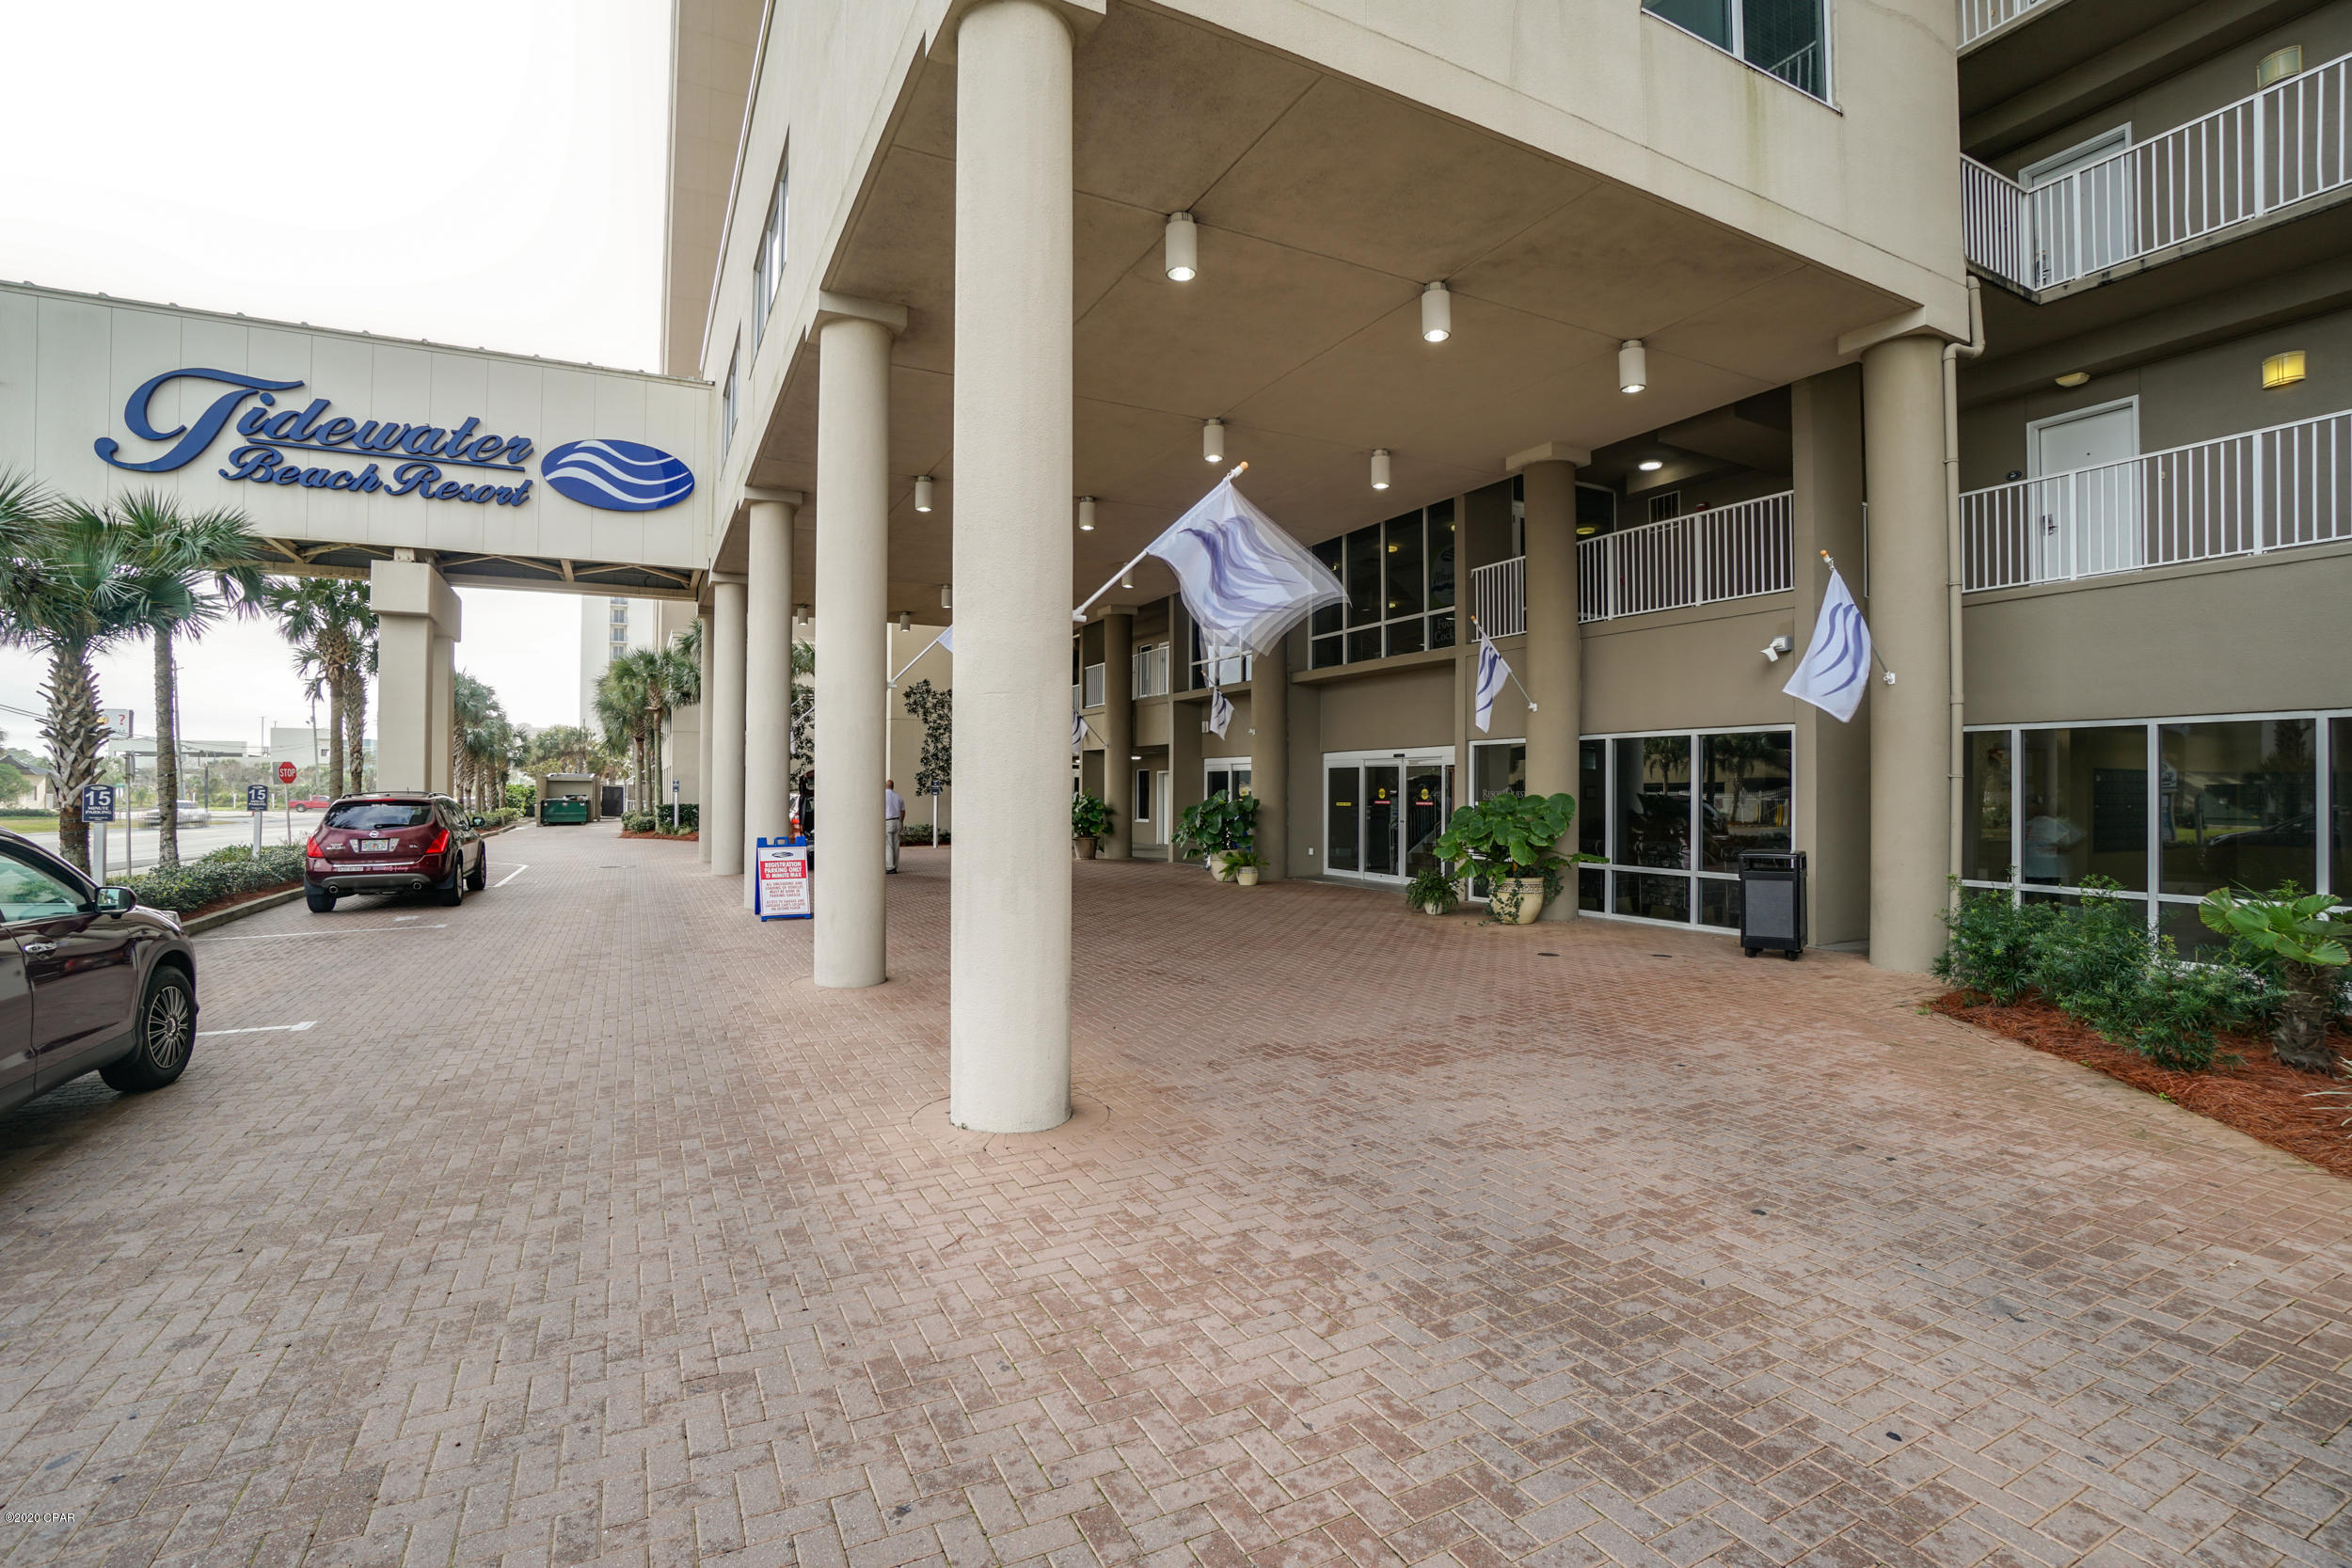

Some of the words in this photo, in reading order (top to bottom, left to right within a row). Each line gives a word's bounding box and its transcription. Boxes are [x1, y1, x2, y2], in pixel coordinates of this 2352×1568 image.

[94, 368, 534, 472] Tidewater
[218, 446, 383, 494] Beach
[381, 460, 533, 508] Resort
[279, 768, 296, 777] STOP
[86, 790, 112, 806] 15
[248, 789, 266, 800] 15
